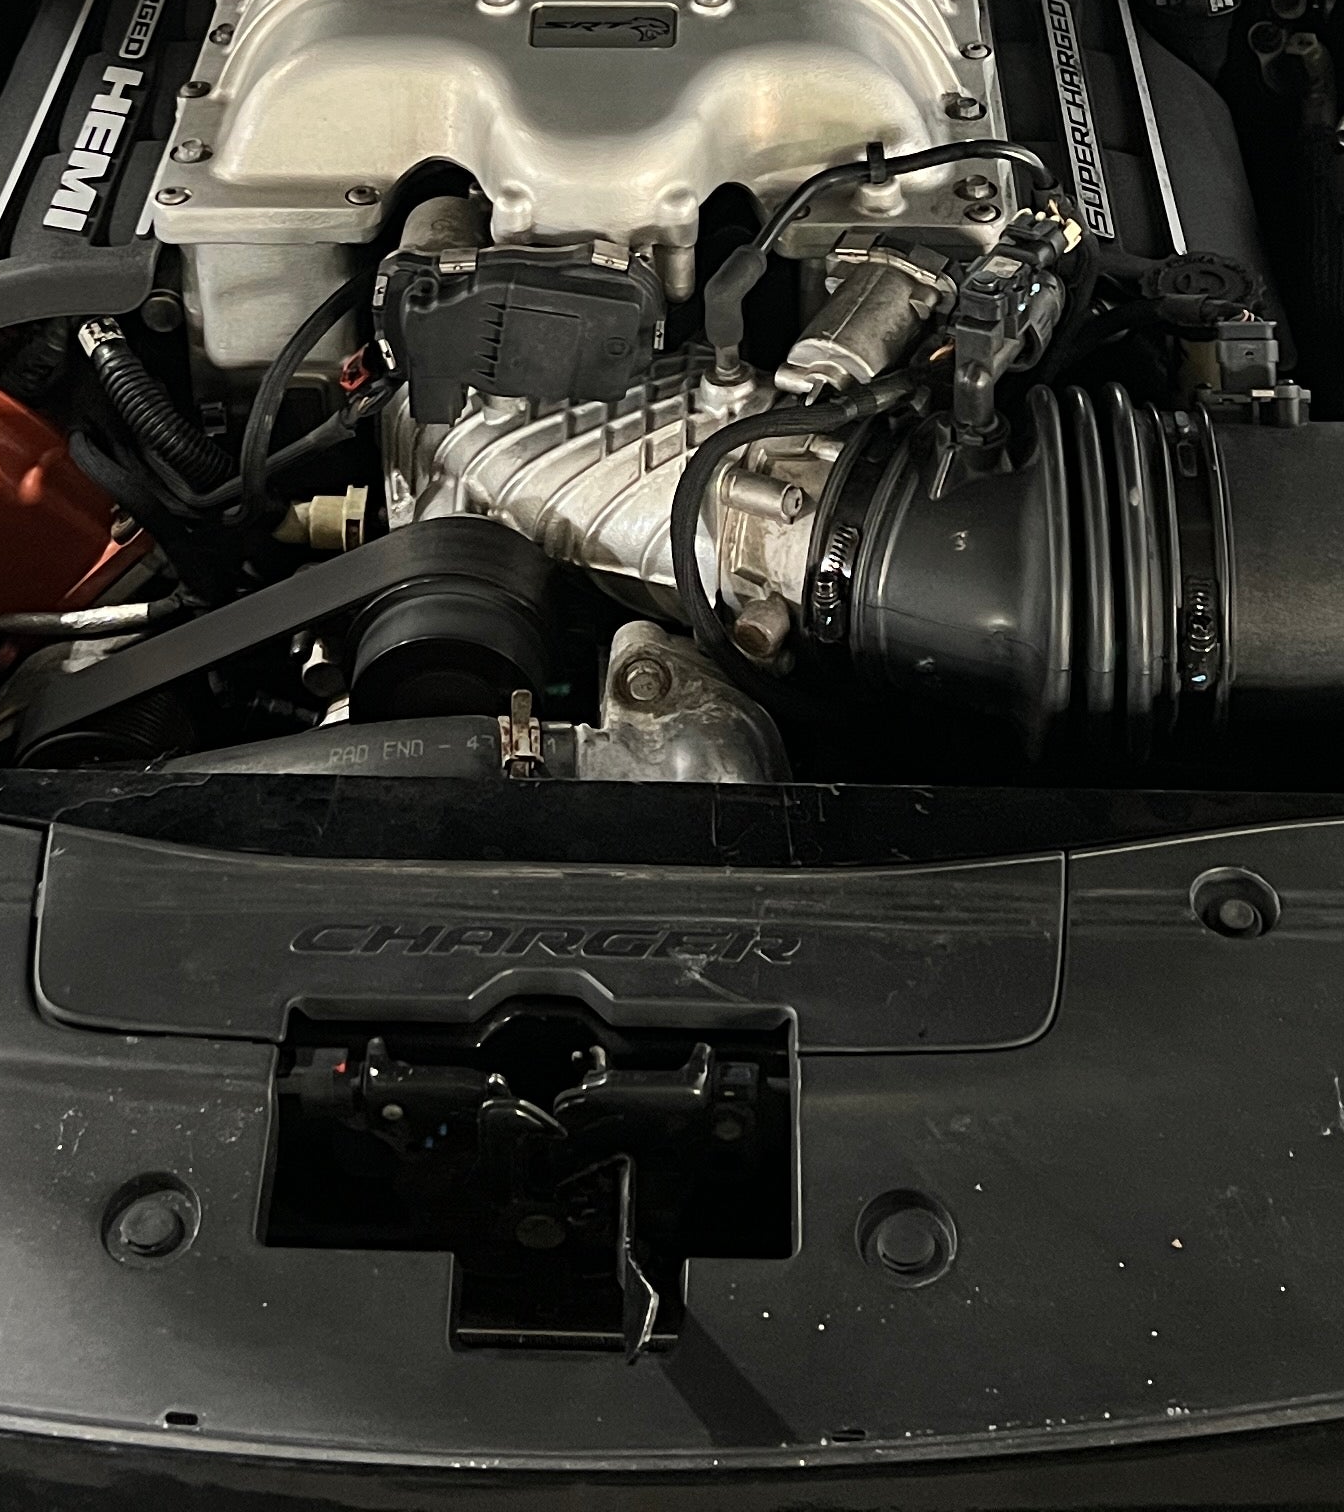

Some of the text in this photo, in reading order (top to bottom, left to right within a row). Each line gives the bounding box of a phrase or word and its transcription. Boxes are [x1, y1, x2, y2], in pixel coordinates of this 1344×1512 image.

[43, 65, 144, 232] HEMI
[329, 744, 368, 765] RAD
[383, 739, 424, 761] END
[289, 923, 802, 965] CHARGER
